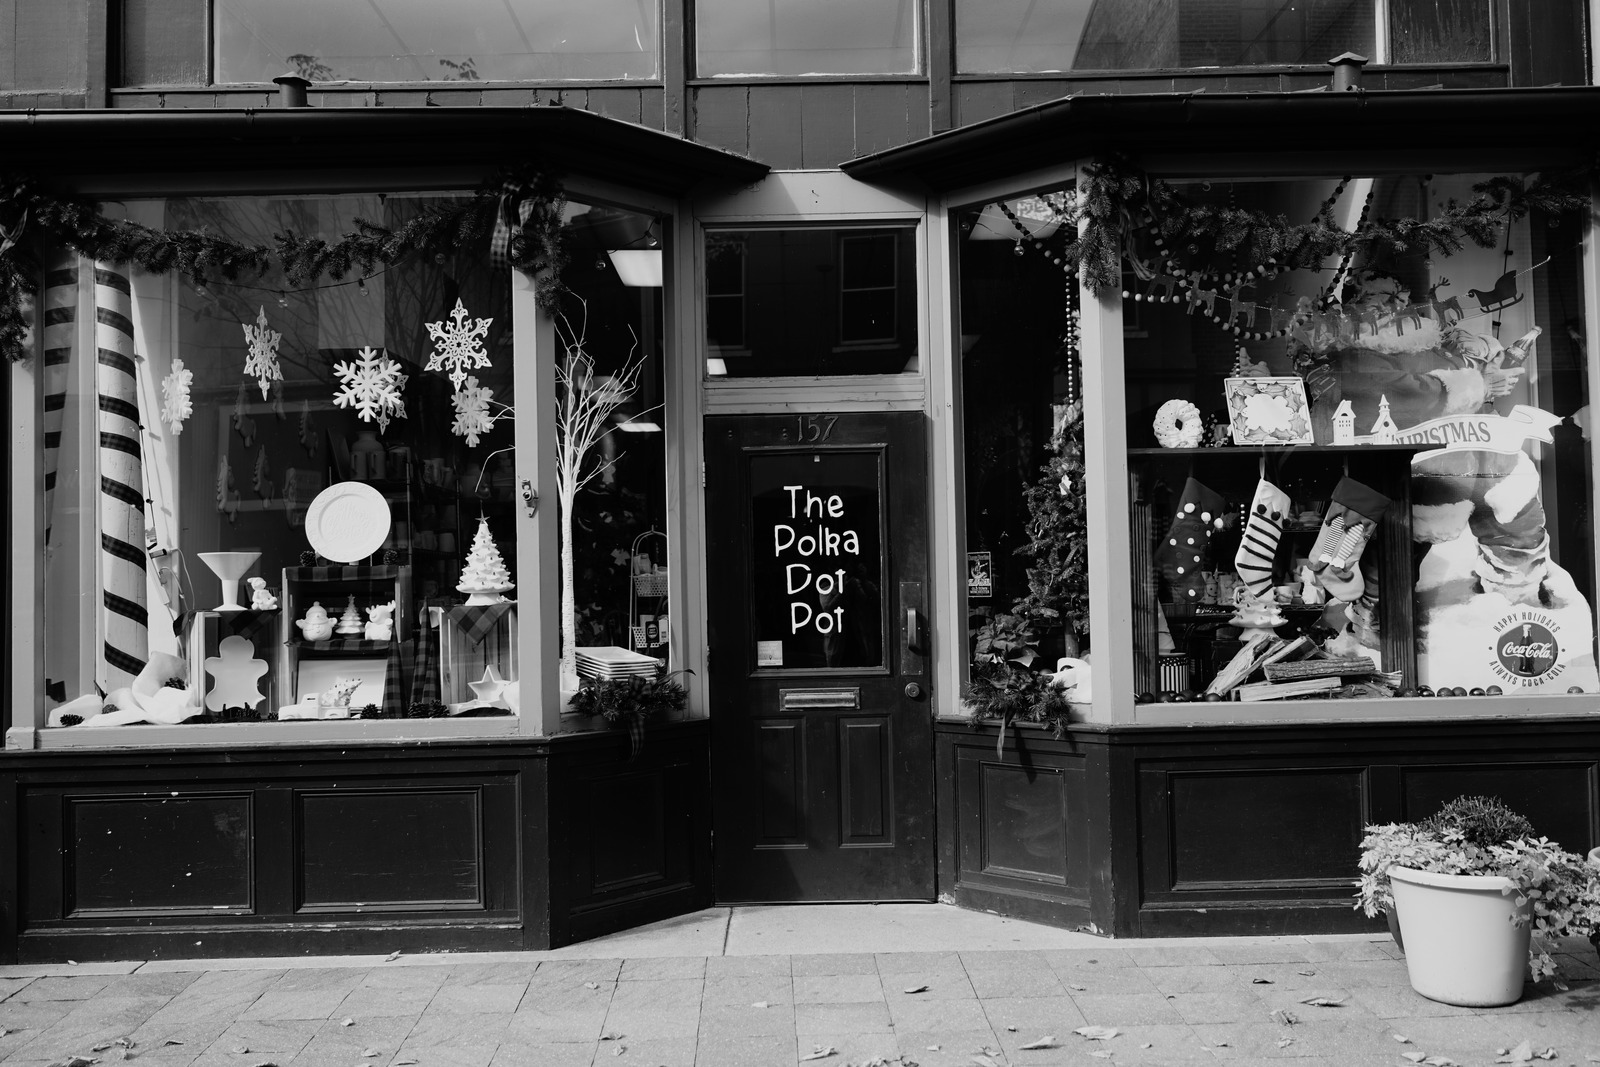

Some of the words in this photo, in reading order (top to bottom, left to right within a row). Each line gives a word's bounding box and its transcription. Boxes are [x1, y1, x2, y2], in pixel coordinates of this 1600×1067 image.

[797, 414, 839, 442] 157
[1396, 421, 1491, 444] RISTMAS
[783, 485, 845, 518] The
[774, 524, 860, 557] Polka
[786, 563, 846, 595] Dot
[790, 602, 845, 635] Pot
[1493, 613, 1517, 632] HAPPY
[1522, 612, 1560, 632] HOLIDAYS
[1502, 642, 1553, 658] Coca-Cola
[1489, 661, 1517, 685] ALWAYS
[1522, 664, 1566, 686] COCA-COLA
